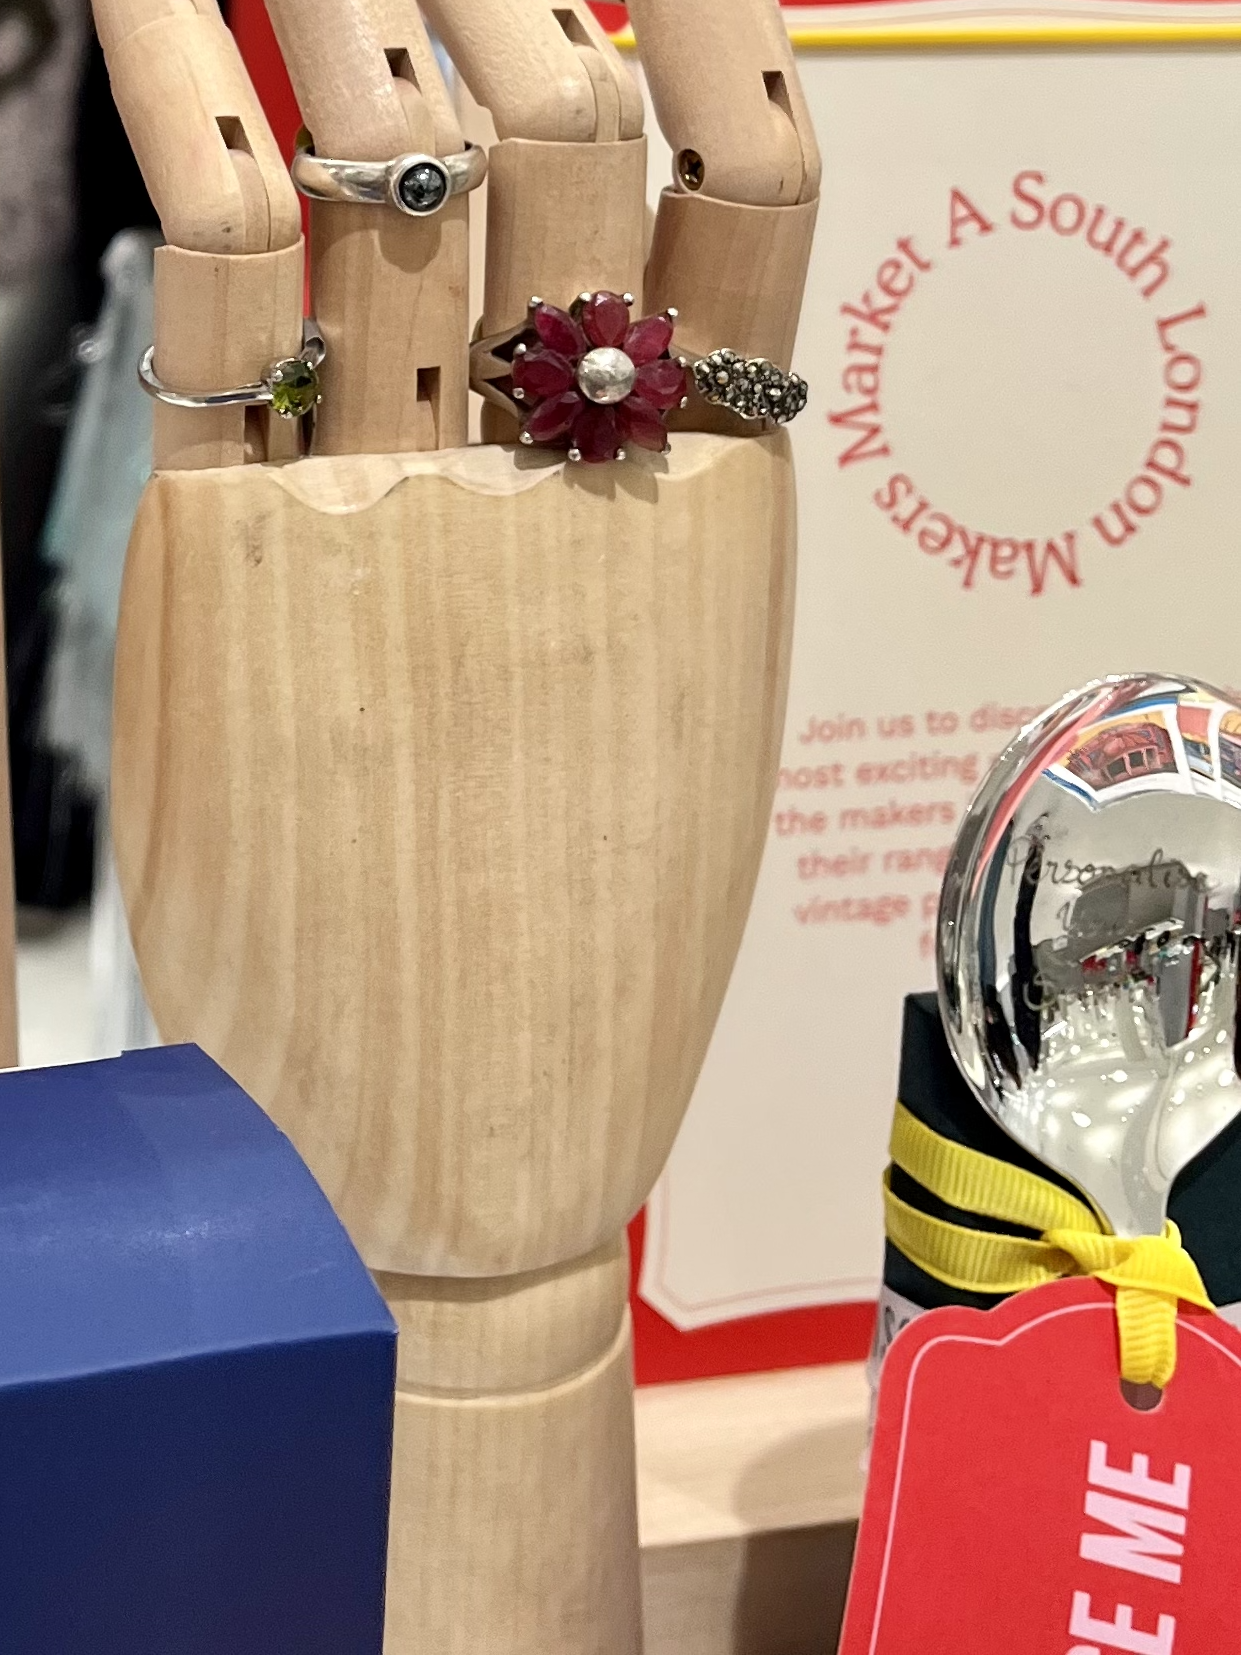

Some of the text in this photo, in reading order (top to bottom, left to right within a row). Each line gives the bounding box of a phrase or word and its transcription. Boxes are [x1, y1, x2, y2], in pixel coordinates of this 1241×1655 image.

[826, 169, 1208, 598] A South London Makers Market
[800, 712, 866, 744] Join
[877, 714, 915, 739] us
[925, 710, 959, 736] to
[855, 752, 979, 785] exciting
[775, 800, 957, 836] the makers
[1079, 1440, 1191, 1584] ME
